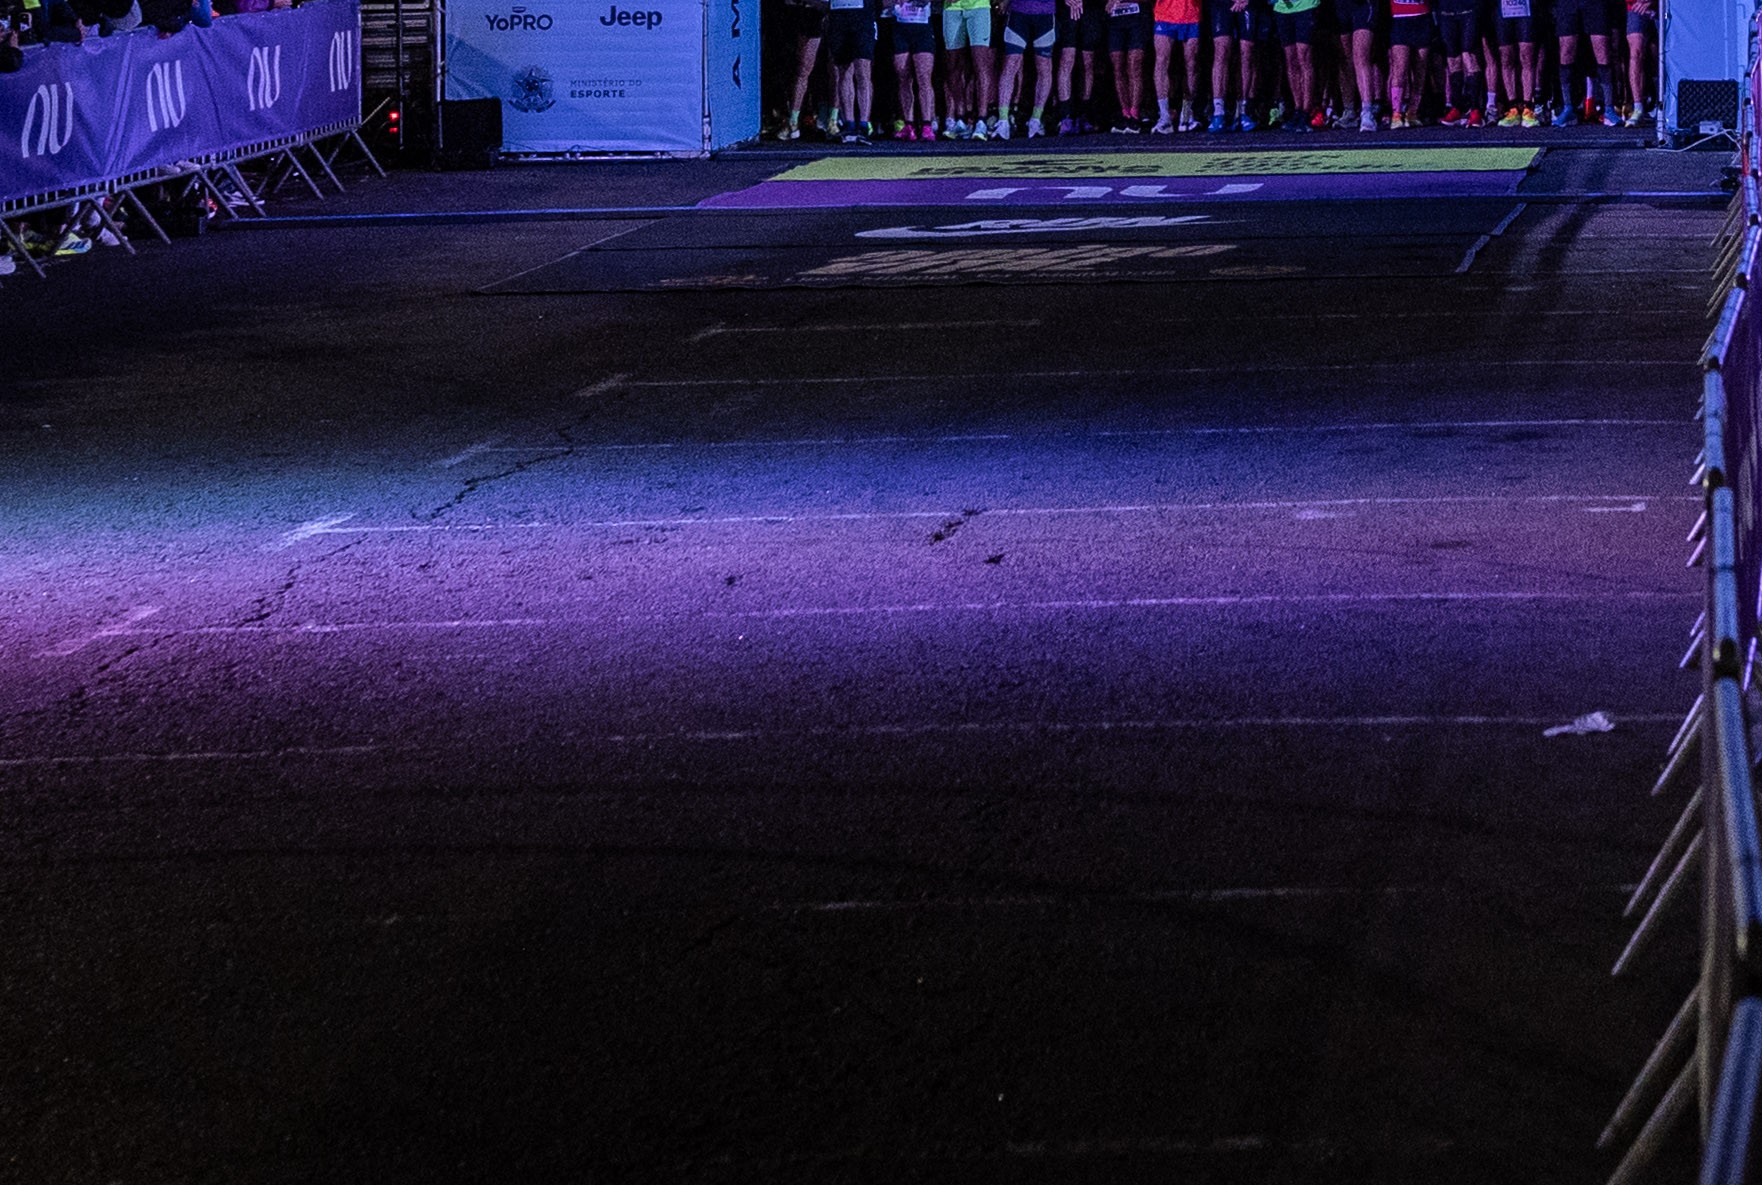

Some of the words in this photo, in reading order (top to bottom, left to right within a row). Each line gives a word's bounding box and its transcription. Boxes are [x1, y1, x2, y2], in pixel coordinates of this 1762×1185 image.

[486, 14, 553, 31] YoPRO
[600, 5, 663, 30] Jeep
[570, 90, 625, 98] ESPORTE
